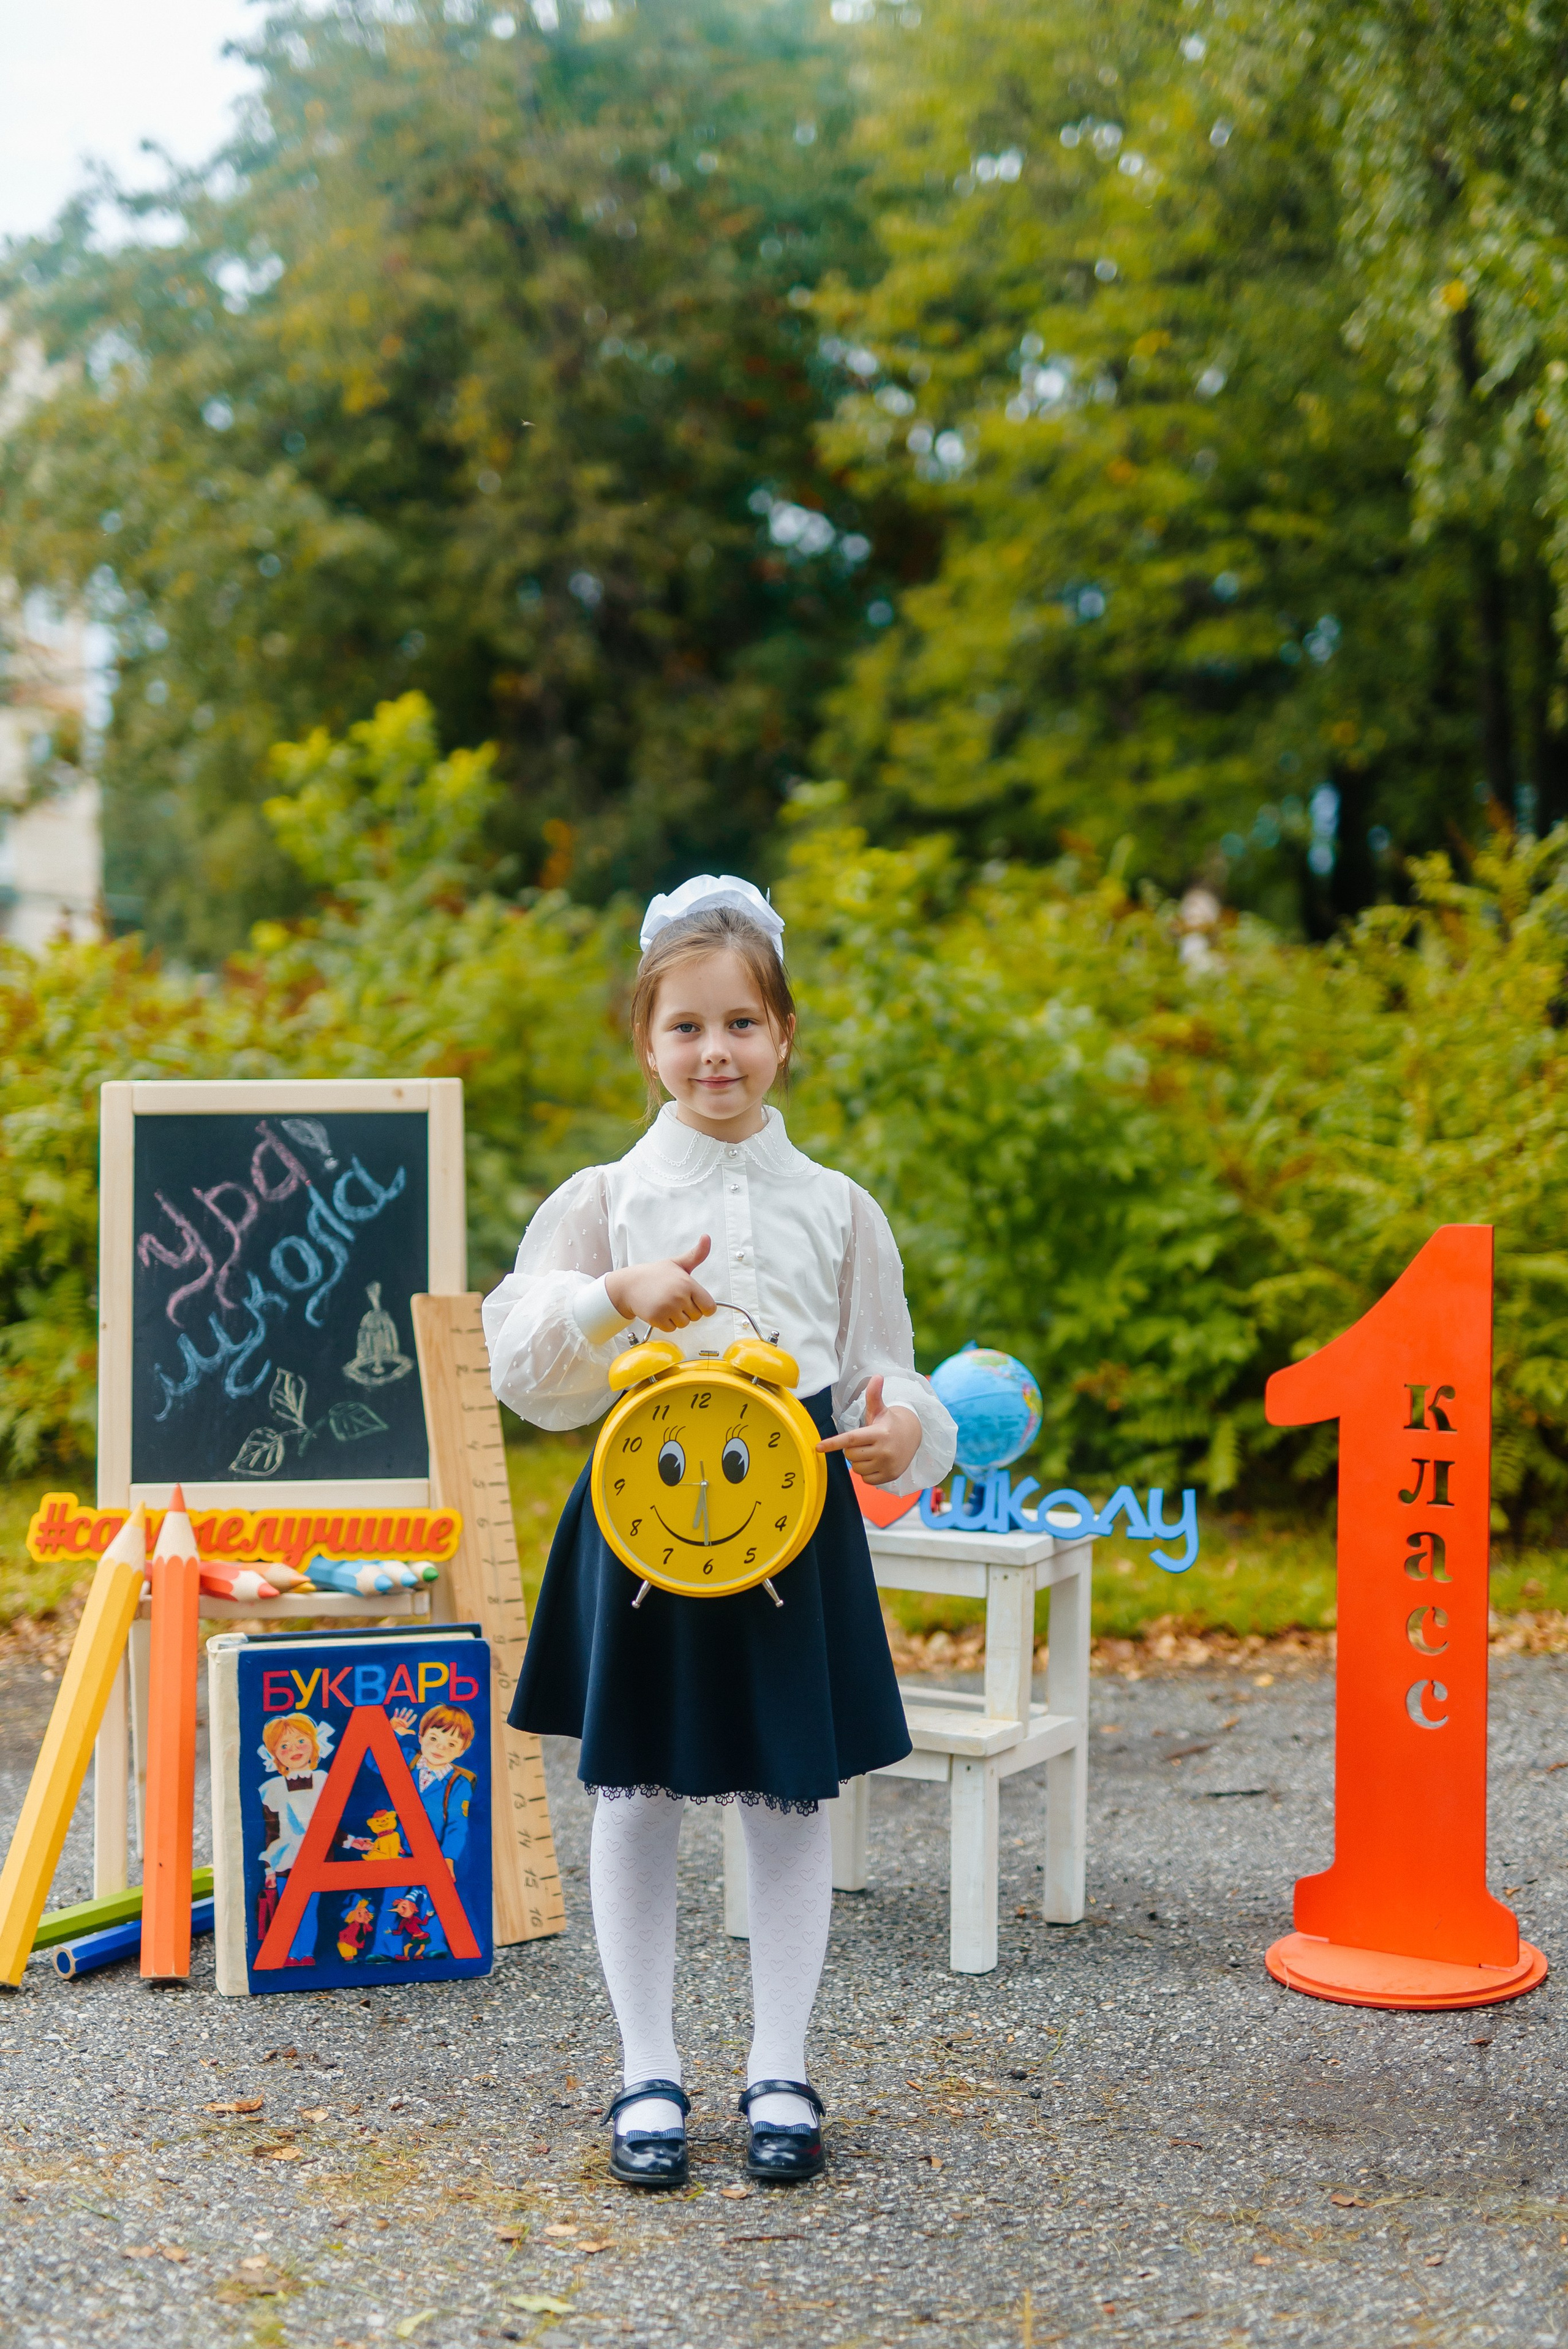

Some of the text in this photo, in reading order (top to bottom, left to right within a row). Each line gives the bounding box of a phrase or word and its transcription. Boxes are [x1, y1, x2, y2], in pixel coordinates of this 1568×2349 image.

[690, 1392, 712, 1409] 12
[652, 1404, 671, 1421] 11
[739, 1403, 748, 1419] 1
[622, 1436, 643, 1454] 10
[767, 1431, 781, 1449] 2
[614, 1478, 625, 1496] 9
[781, 1472, 796, 1489] 3
[476, 1517, 490, 1528] 6
[630, 1519, 643, 1537] 8
[774, 1515, 788, 1532] 4
[662, 1548, 674, 1565] 7
[743, 1547, 758, 1564] 5
[1398, 1384, 1458, 1729] класс
[702, 1559, 714, 1575] 6
[487, 1595, 500, 1605] 8
[262, 1662, 479, 1712] БУКВАРЬ
[497, 1670, 510, 1690] 10
[508, 1750, 520, 1770] 12
[513, 1792, 527, 1810] 13
[253, 1705, 483, 1970] А
[518, 1829, 532, 1849] 14
[524, 1868, 540, 1889] 15
[529, 1907, 543, 1928] 16
